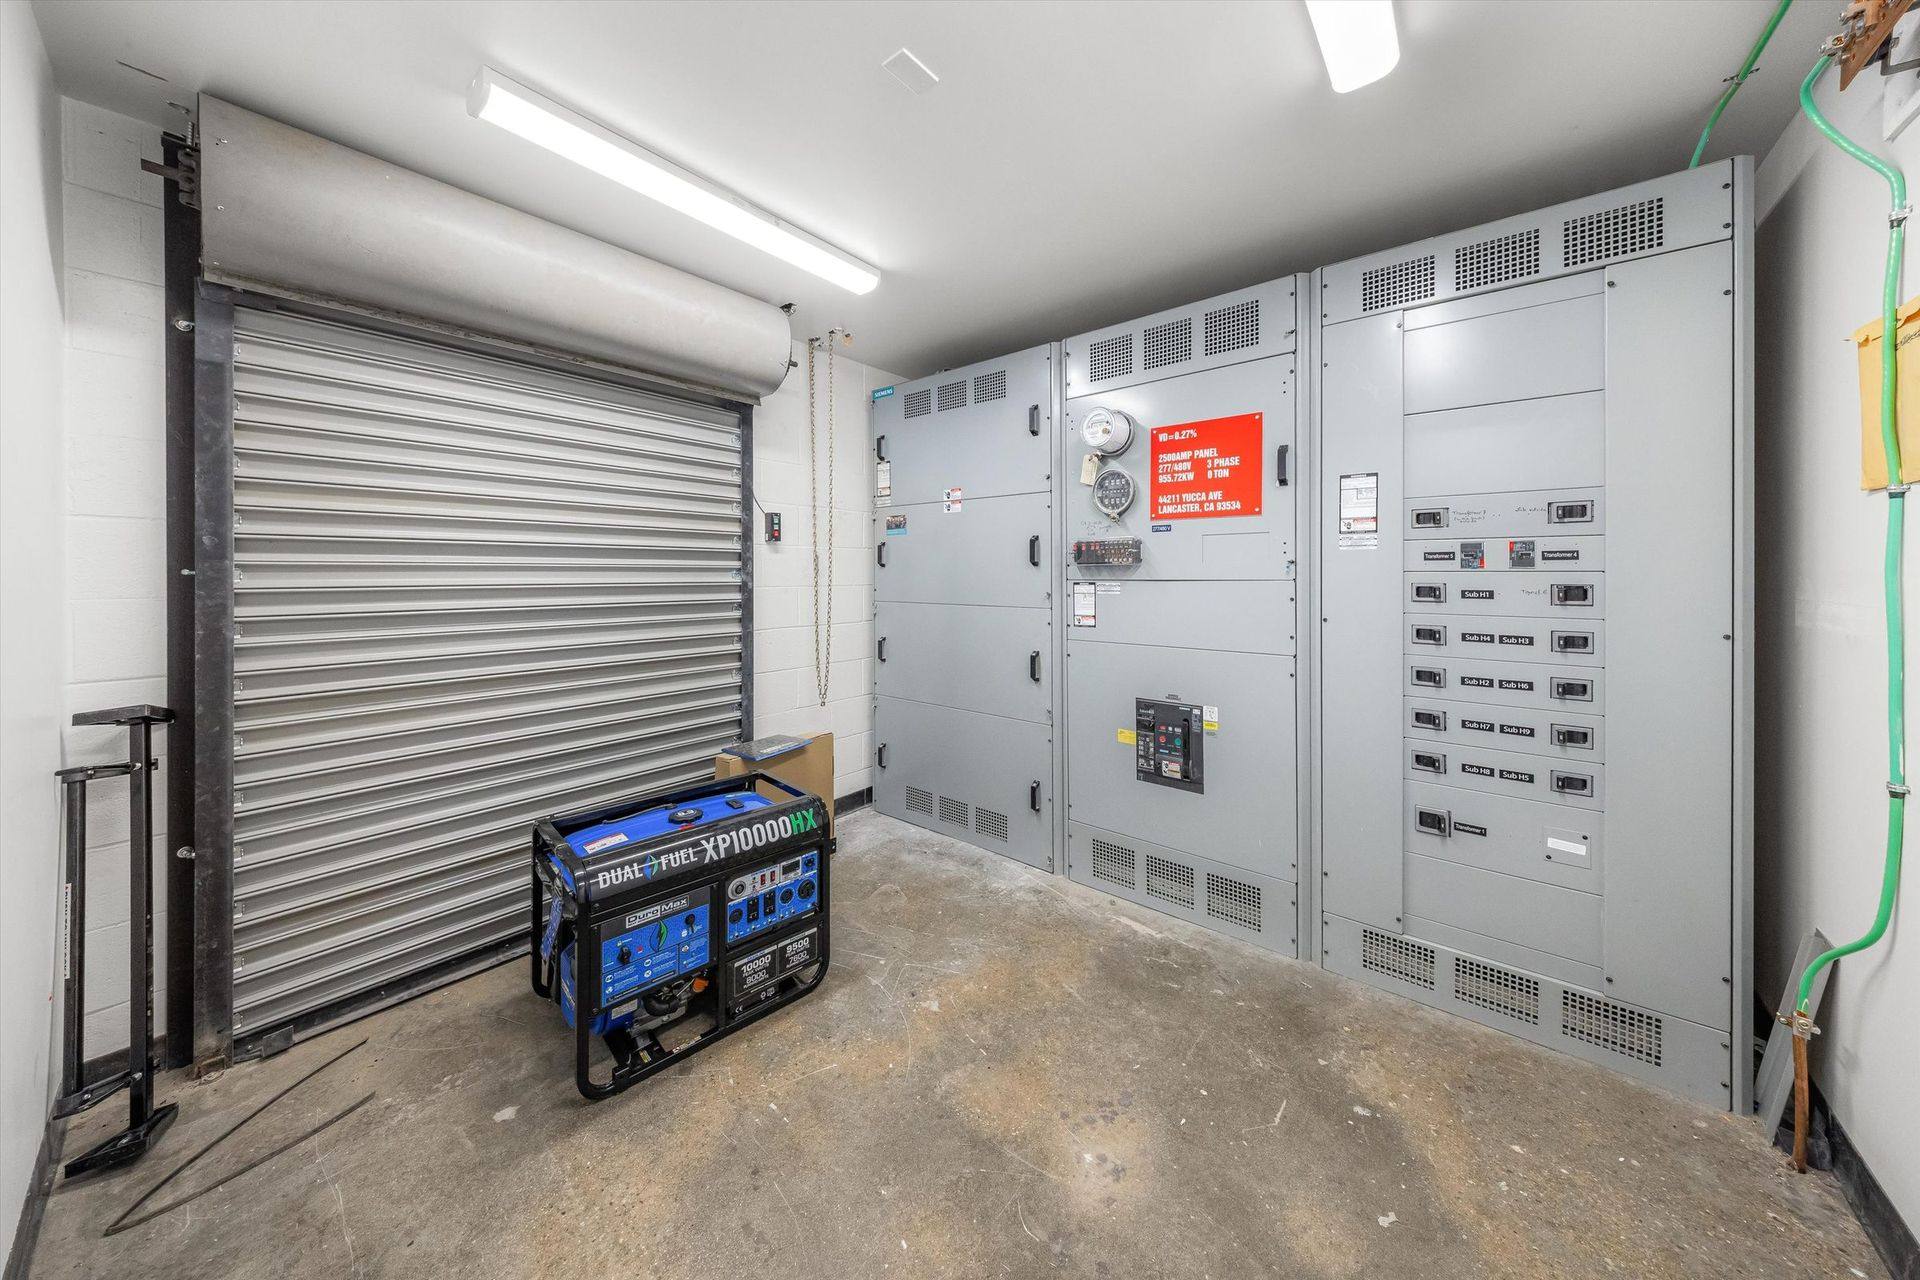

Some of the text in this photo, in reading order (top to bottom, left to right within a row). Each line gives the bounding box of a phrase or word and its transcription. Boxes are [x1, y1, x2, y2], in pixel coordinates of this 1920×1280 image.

[1158, 448, 1218, 463] 2500AMP PANEL
[1158, 462, 1192, 473] 277/480V
[1207, 456, 1240, 469] 3 PHASE
[1158, 472, 1194, 483] 955.72KW
[1207, 469, 1229, 479] 0 TON
[1158, 491, 1222, 504] 44211 YUCCA AVE
[1204, 502, 1214, 512] CA
[1216, 501, 1240, 511] 93534
[1503, 772, 1517, 780] Sub
[598, 808, 818, 890] DUAL FUEL XP10000HX
[786, 937, 810, 953] 9500
[741, 954, 772, 973] 10000
[789, 950, 807, 964] 7600
[746, 970, 766, 984] 8000
